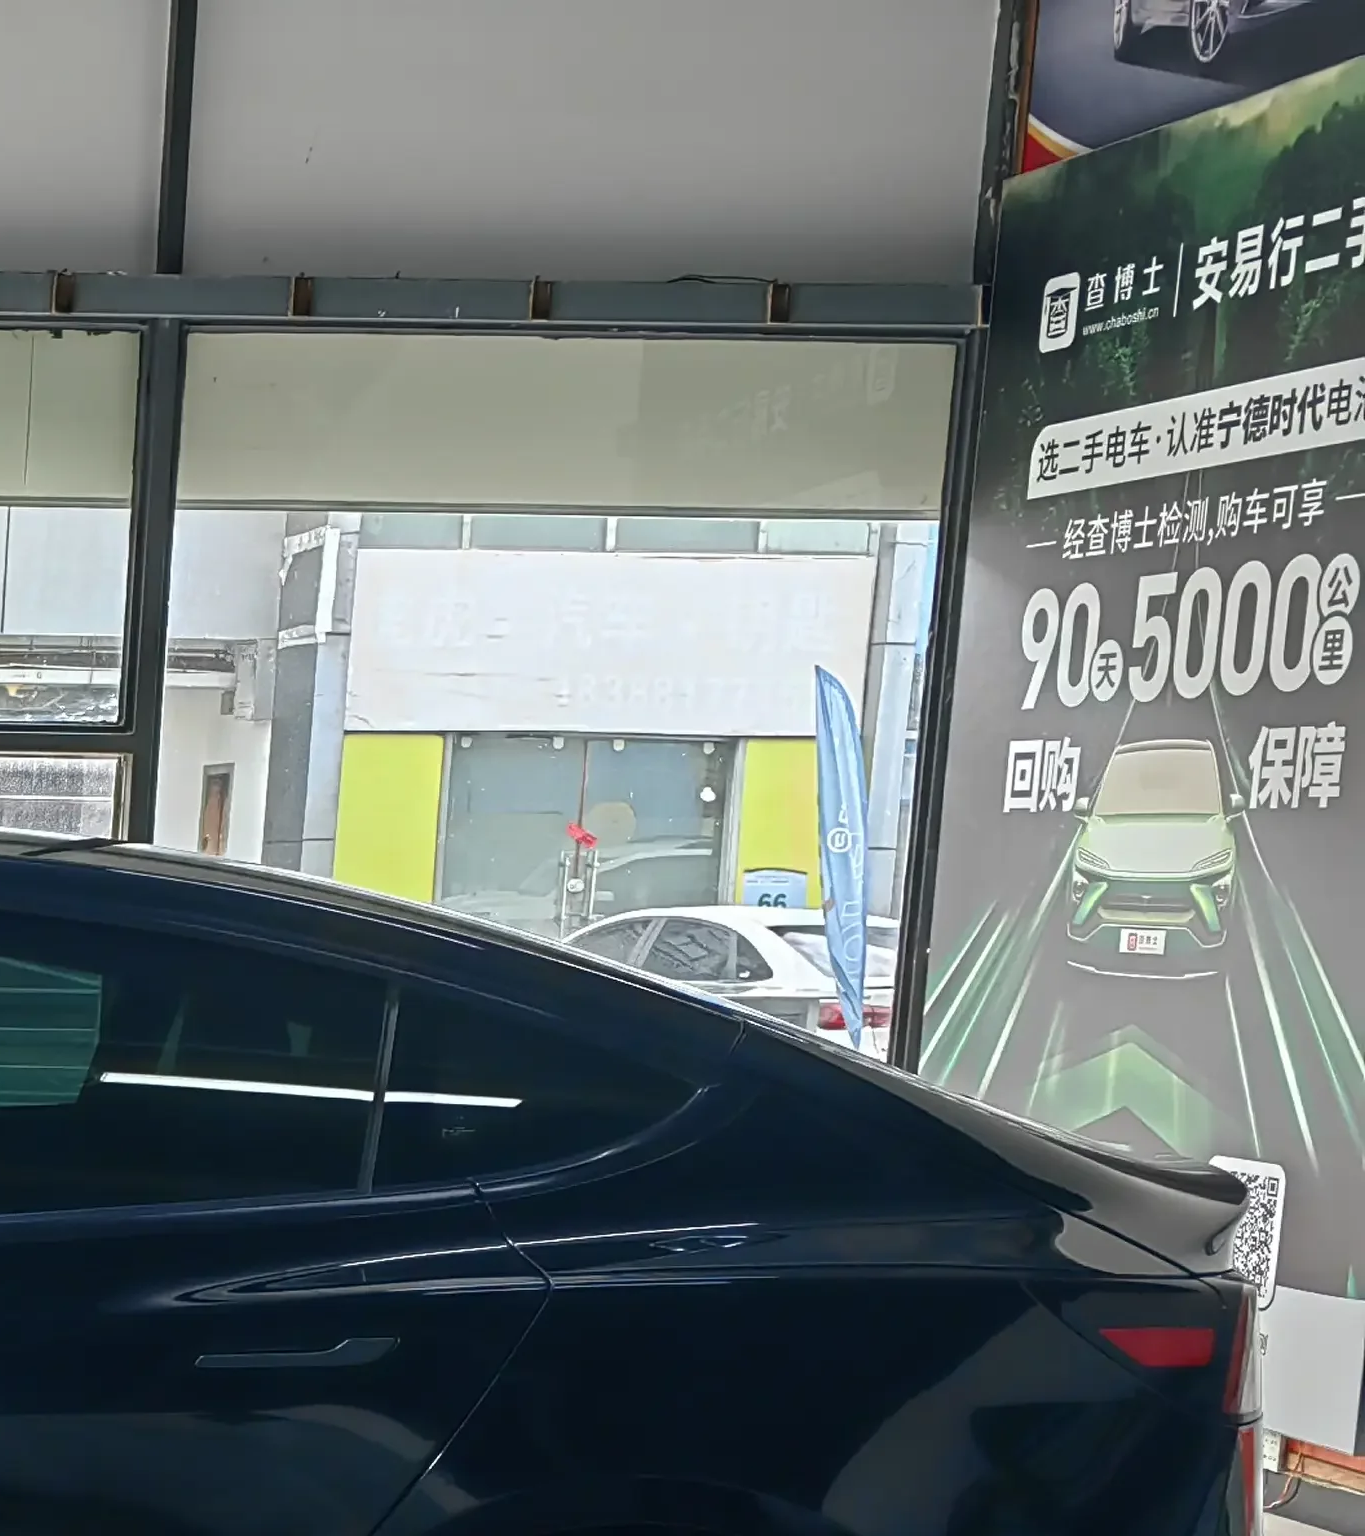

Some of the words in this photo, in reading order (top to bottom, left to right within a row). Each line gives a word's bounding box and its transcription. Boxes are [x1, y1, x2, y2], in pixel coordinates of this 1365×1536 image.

[1084, 256, 1164, 312] 查博士
[1082, 306, 1159, 336] www.chaboshi.cn
[1003, 736, 1082, 813] 回购
[1249, 721, 1347, 810] 保障
